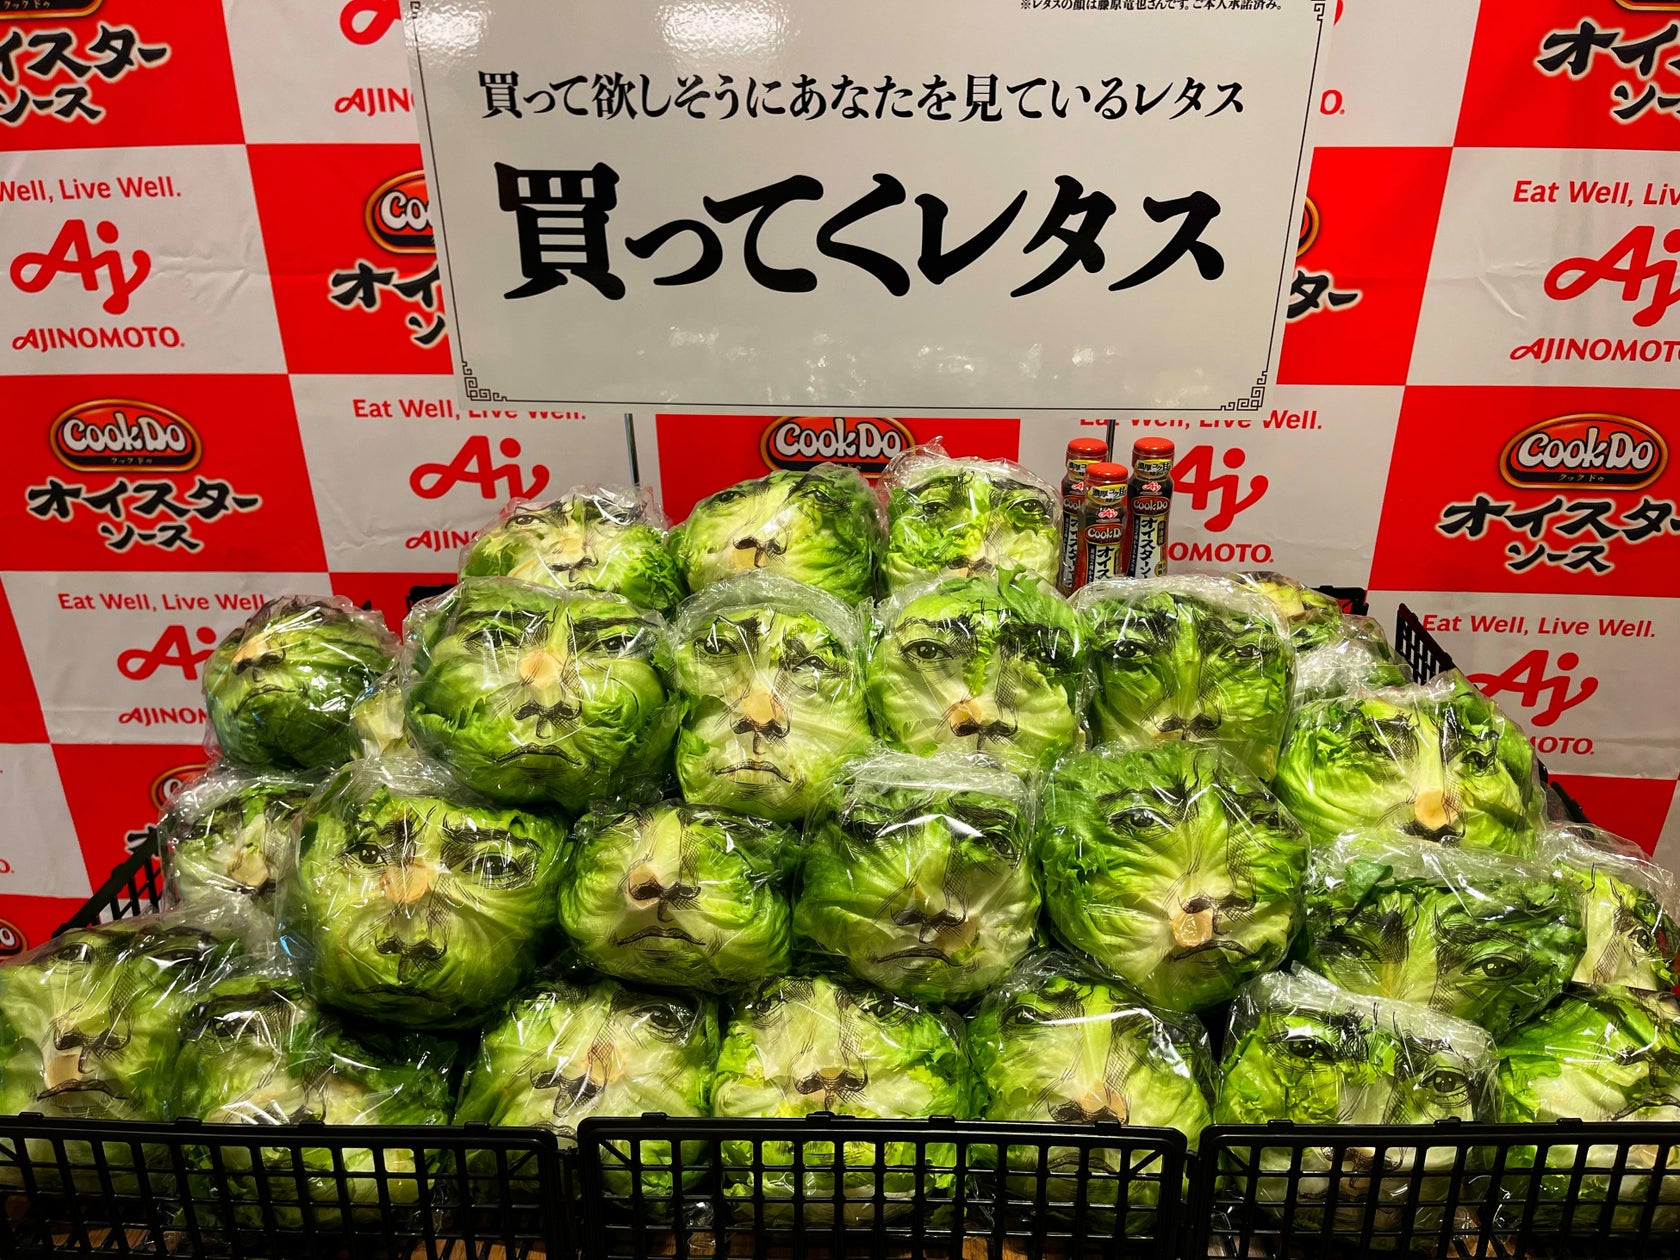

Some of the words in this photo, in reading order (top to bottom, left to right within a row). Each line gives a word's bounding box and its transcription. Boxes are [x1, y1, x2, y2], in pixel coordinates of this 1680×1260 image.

[1536, 21, 1680, 76] オイ
[334, 88, 415, 117] AJIN
[478, 70, 1244, 122] 買って欲しそうにあなたを見ているレタス
[58, 178, 112, 200] Live
[116, 176, 181, 198] Well.
[1513, 180, 1560, 203] Eat
[1569, 181, 1634, 207] Well,
[494, 161, 1224, 300] 買ってくレタス
[1509, 337, 1680, 364] AJINOMOT
[353, 399, 393, 418] Eat
[398, 399, 460, 420] Well,
[28, 479, 259, 519] オイスター
[101, 519, 201, 550] ソース
[405, 530, 478, 552] AJIN
[1140, 518, 1157, 579] オイスターソ
[1507, 544, 1611, 572] ソース
[58, 593, 96, 610] Eat
[99, 594, 157, 612] Well,
[162, 594, 210, 610] Live
[1423, 614, 1462, 632] Eat
[1470, 615, 1529, 635] Well,
[1538, 617, 1590, 635] Live
[1599, 619, 1656, 637] Well.
